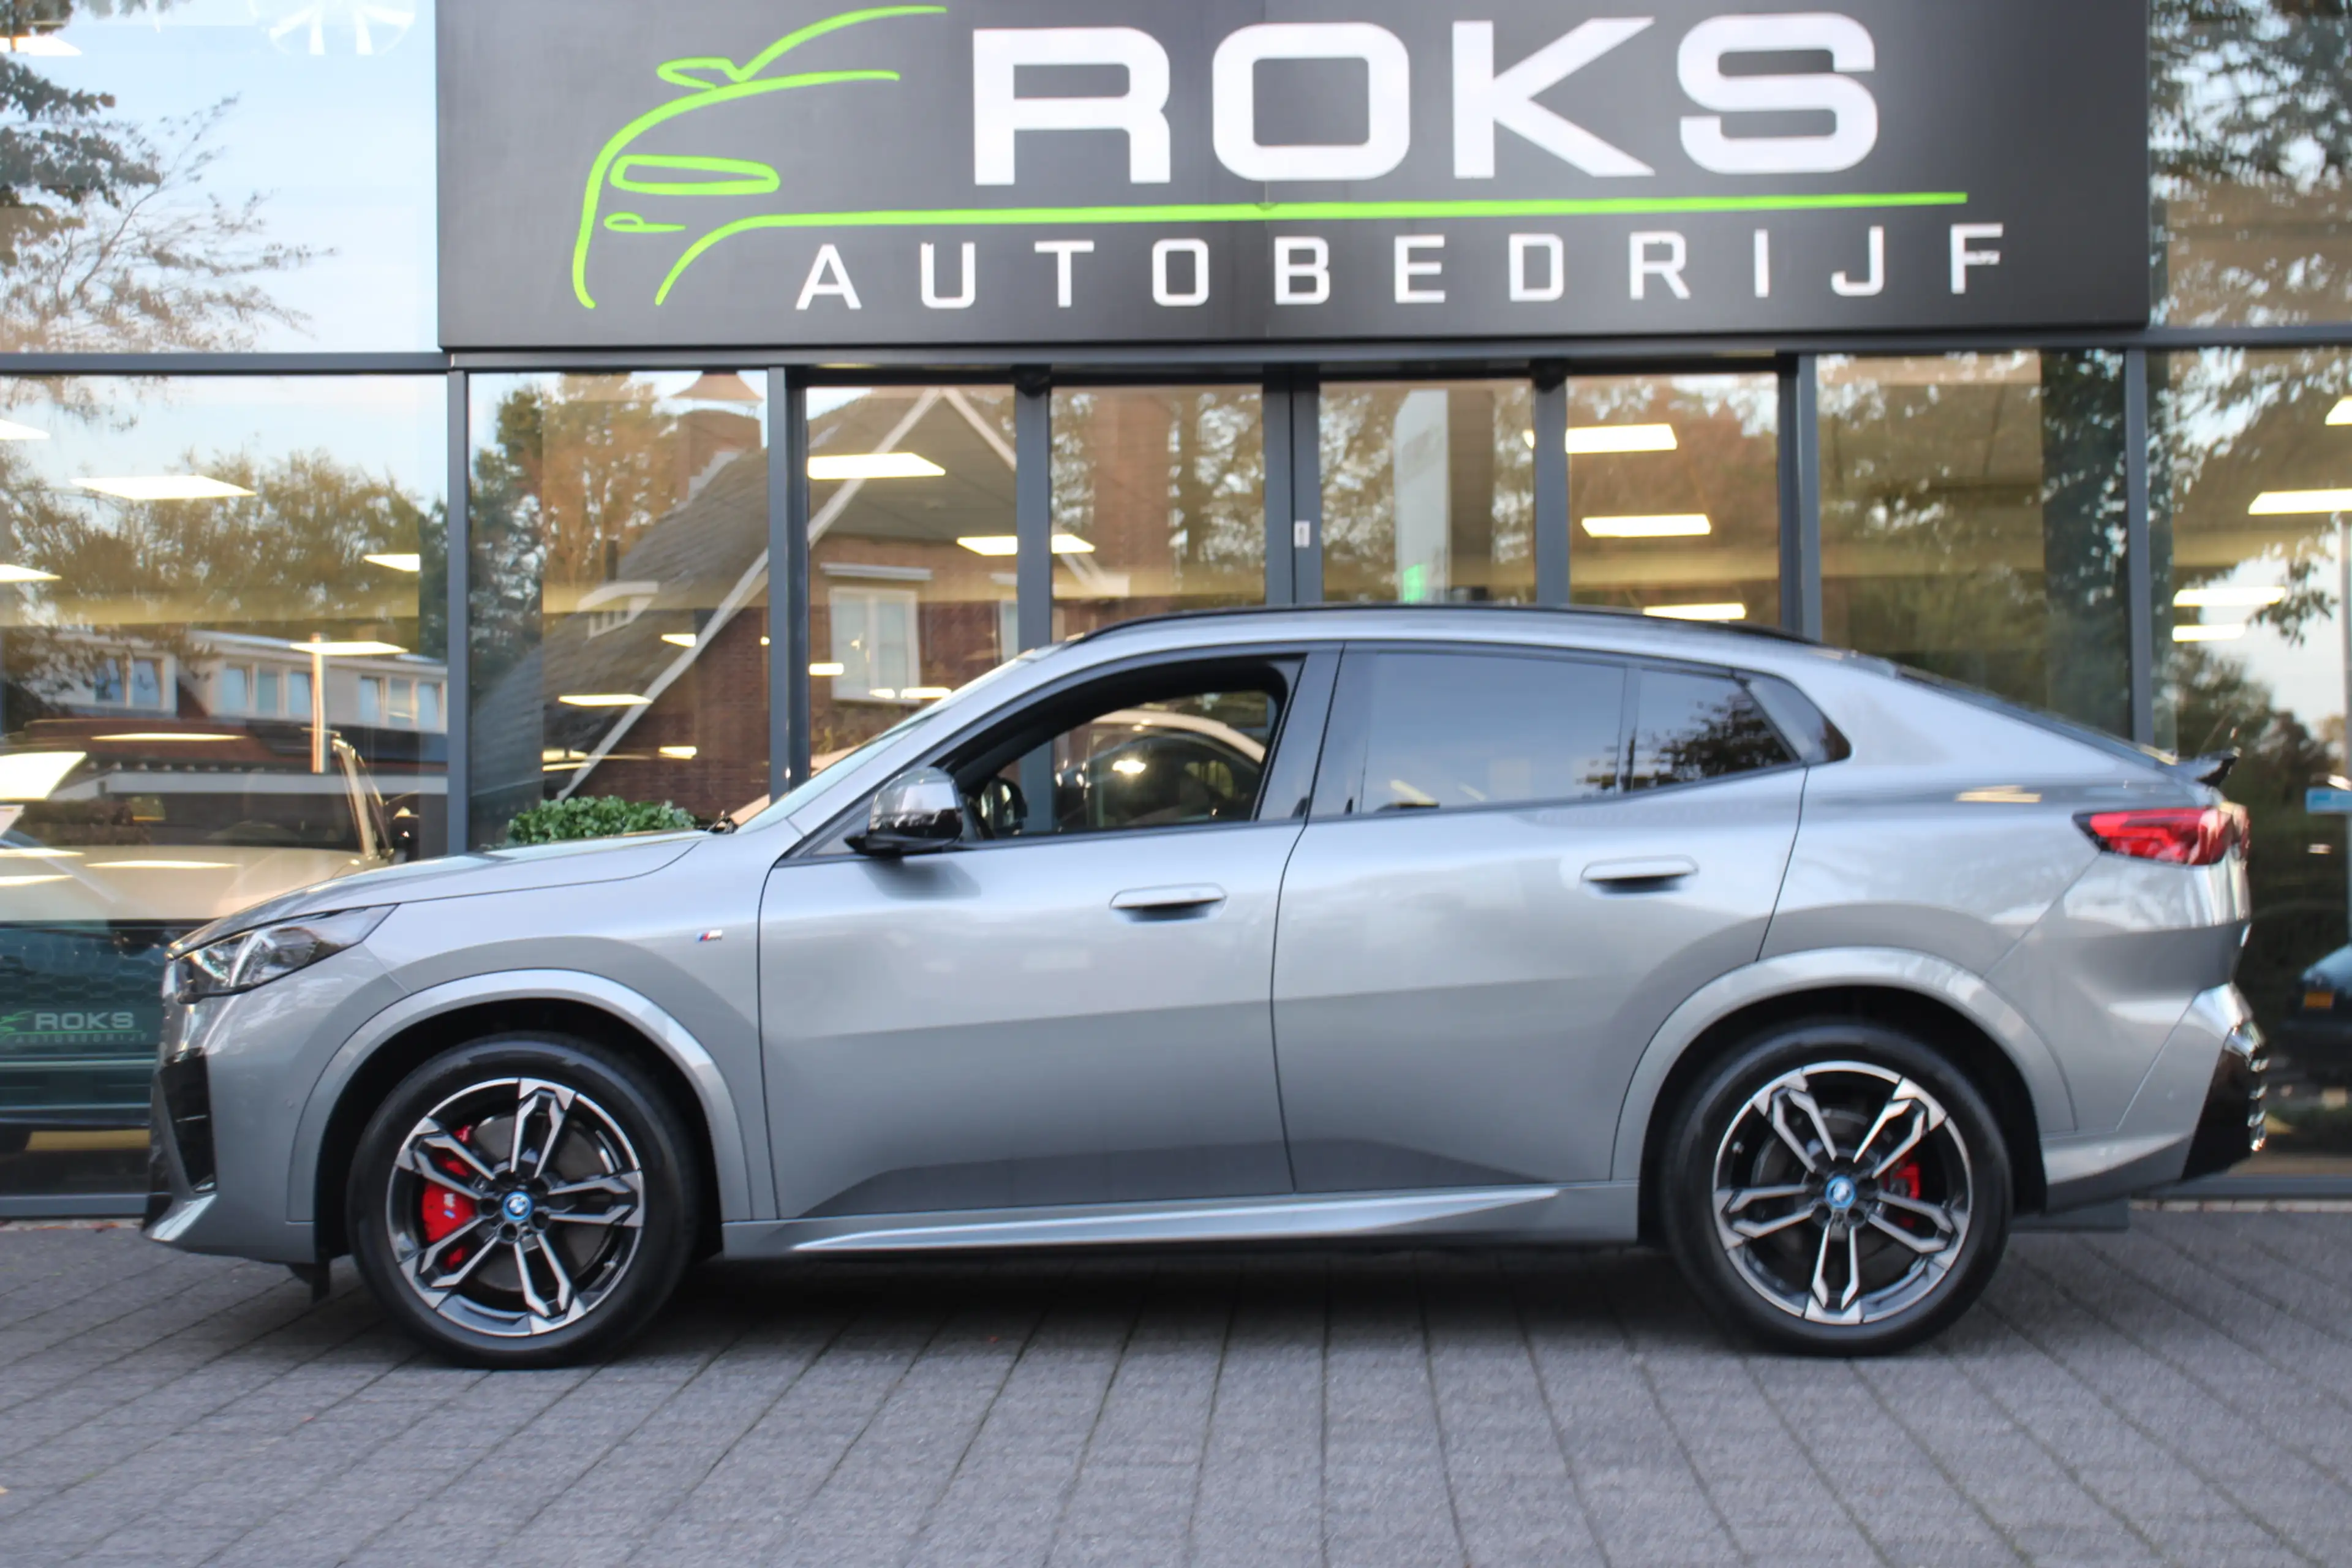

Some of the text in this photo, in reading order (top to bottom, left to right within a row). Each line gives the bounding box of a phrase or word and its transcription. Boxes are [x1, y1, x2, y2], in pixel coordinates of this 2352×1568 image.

[973, 12, 1879, 186] ROKS
[796, 223, 2004, 311] AUTOBEDRIJF
[35, 1012, 134, 1030] ROKS
